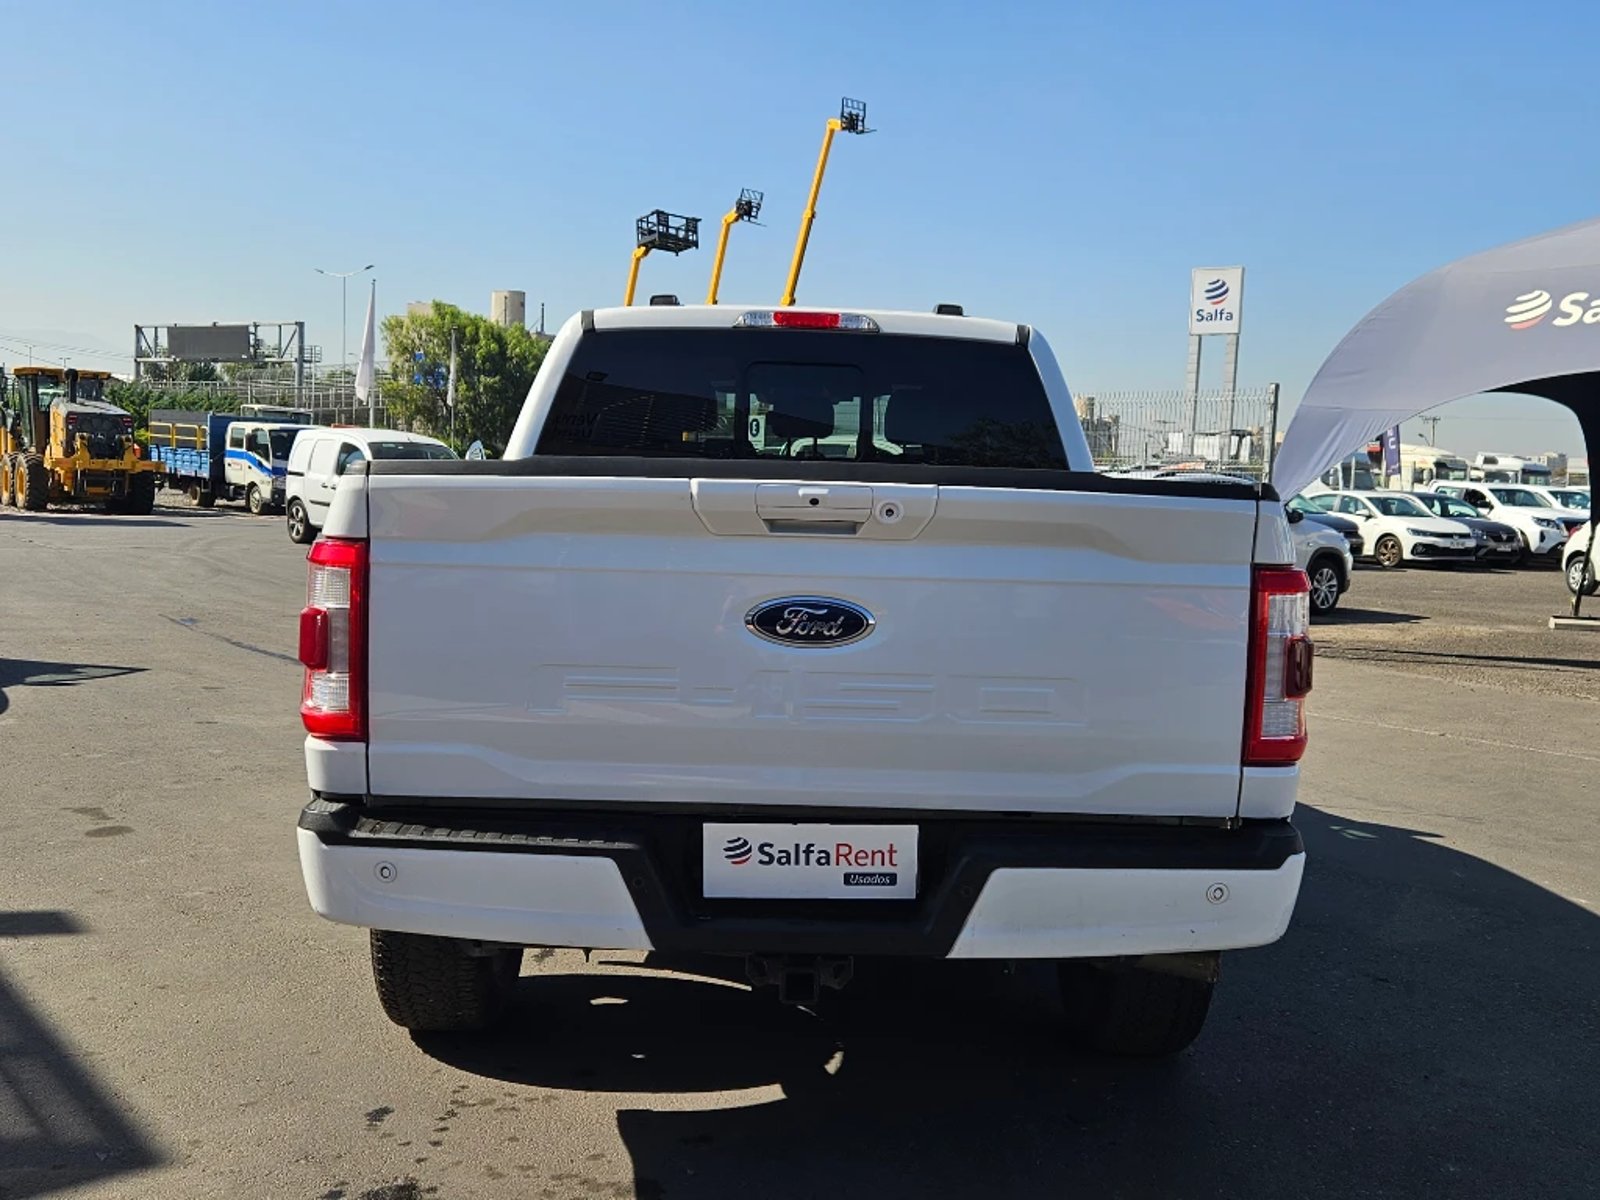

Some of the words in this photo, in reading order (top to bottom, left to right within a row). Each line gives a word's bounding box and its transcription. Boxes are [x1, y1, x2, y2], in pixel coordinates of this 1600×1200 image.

[1195, 308, 1234, 322] Salfa
[775, 606, 845, 636] Ford
[757, 842, 898, 867] SalfaRent
[849, 874, 891, 885] Usados
